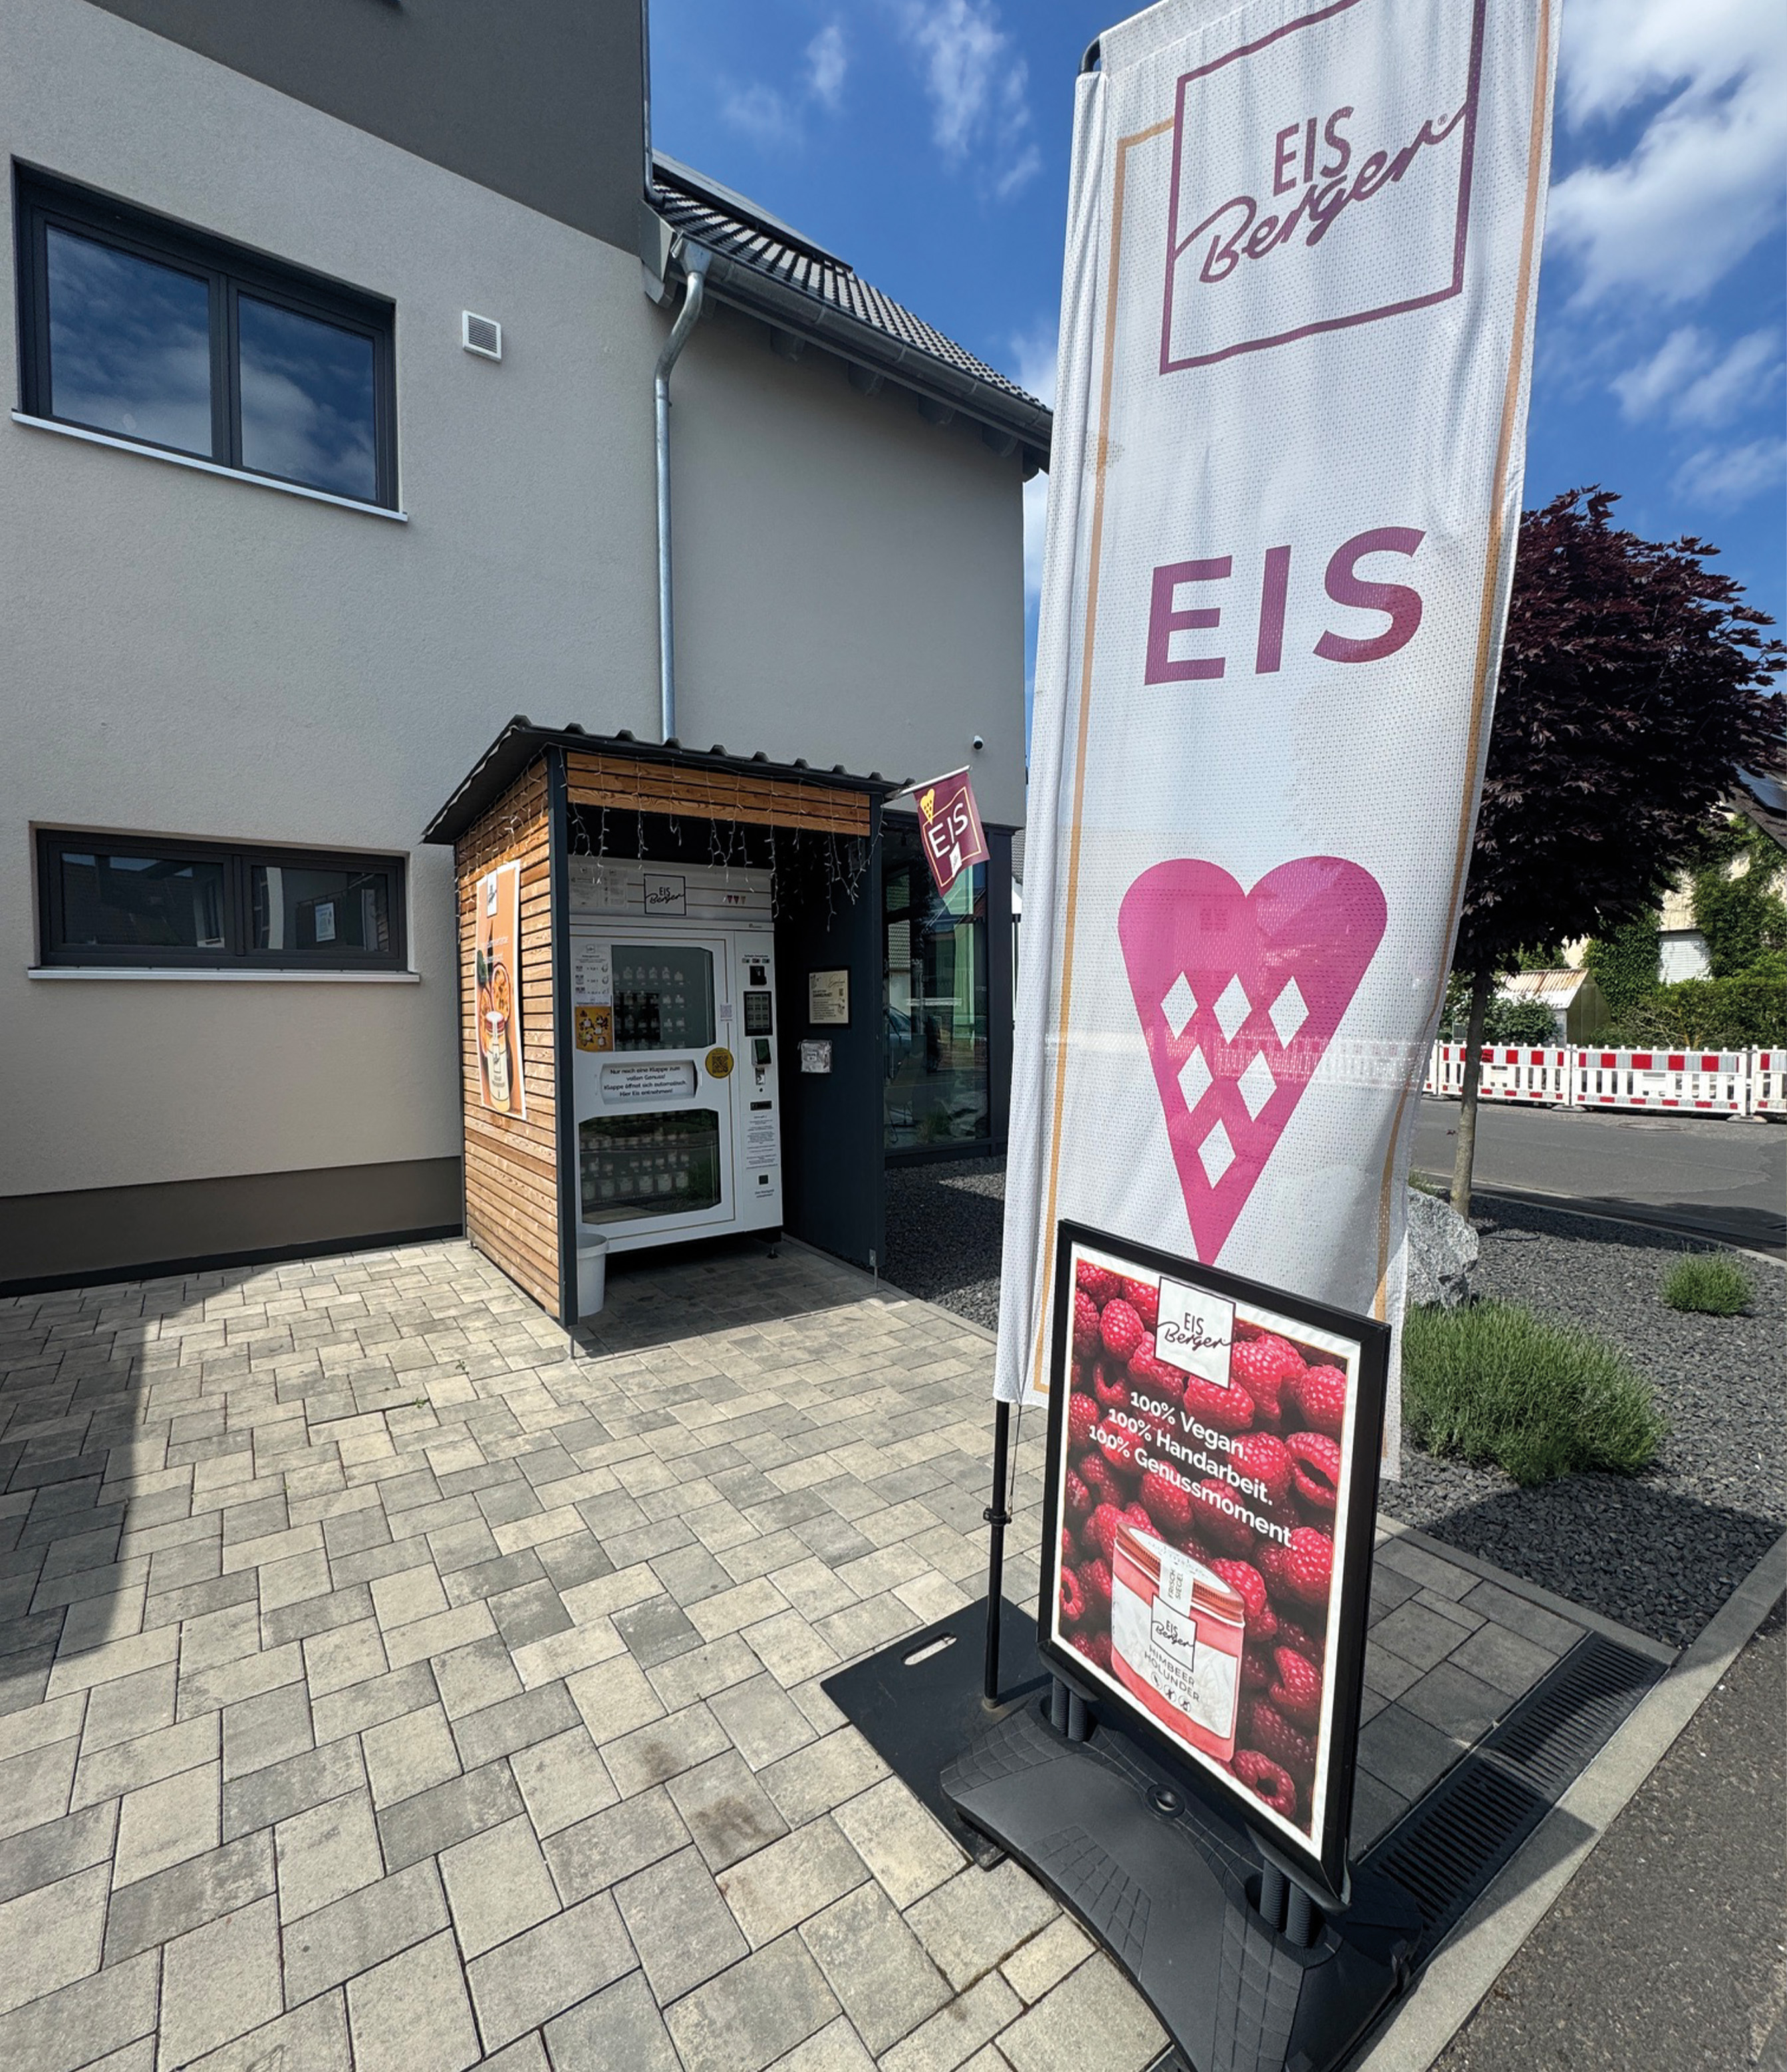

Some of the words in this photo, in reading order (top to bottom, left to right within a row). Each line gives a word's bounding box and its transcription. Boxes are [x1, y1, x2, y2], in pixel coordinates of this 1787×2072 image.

[1273, 106, 1354, 197] EIS
[1145, 526, 1426, 685] EIS
[928, 802, 968, 858] EIS
[659, 887, 670, 897] EIS
[1157, 1321, 1232, 1351] Berger
[1184, 1312, 1204, 1335] EIS
[1131, 1392, 1176, 1425] 100%
[1180, 1411, 1248, 1461] Vegan.
[1109, 1408, 1152, 1442] 100%
[1157, 1429, 1273, 1505] Handarbeit.
[1089, 1425, 1131, 1458] 100%
[1134, 1448, 1298, 1550] Genussmoment.
[1152, 1620, 1194, 1647] Berger
[1166, 1620, 1178, 1637] EIS
[1145, 1651, 1200, 1702] HOLUNDER
[1149, 1644, 1195, 1688] HIMBEER
